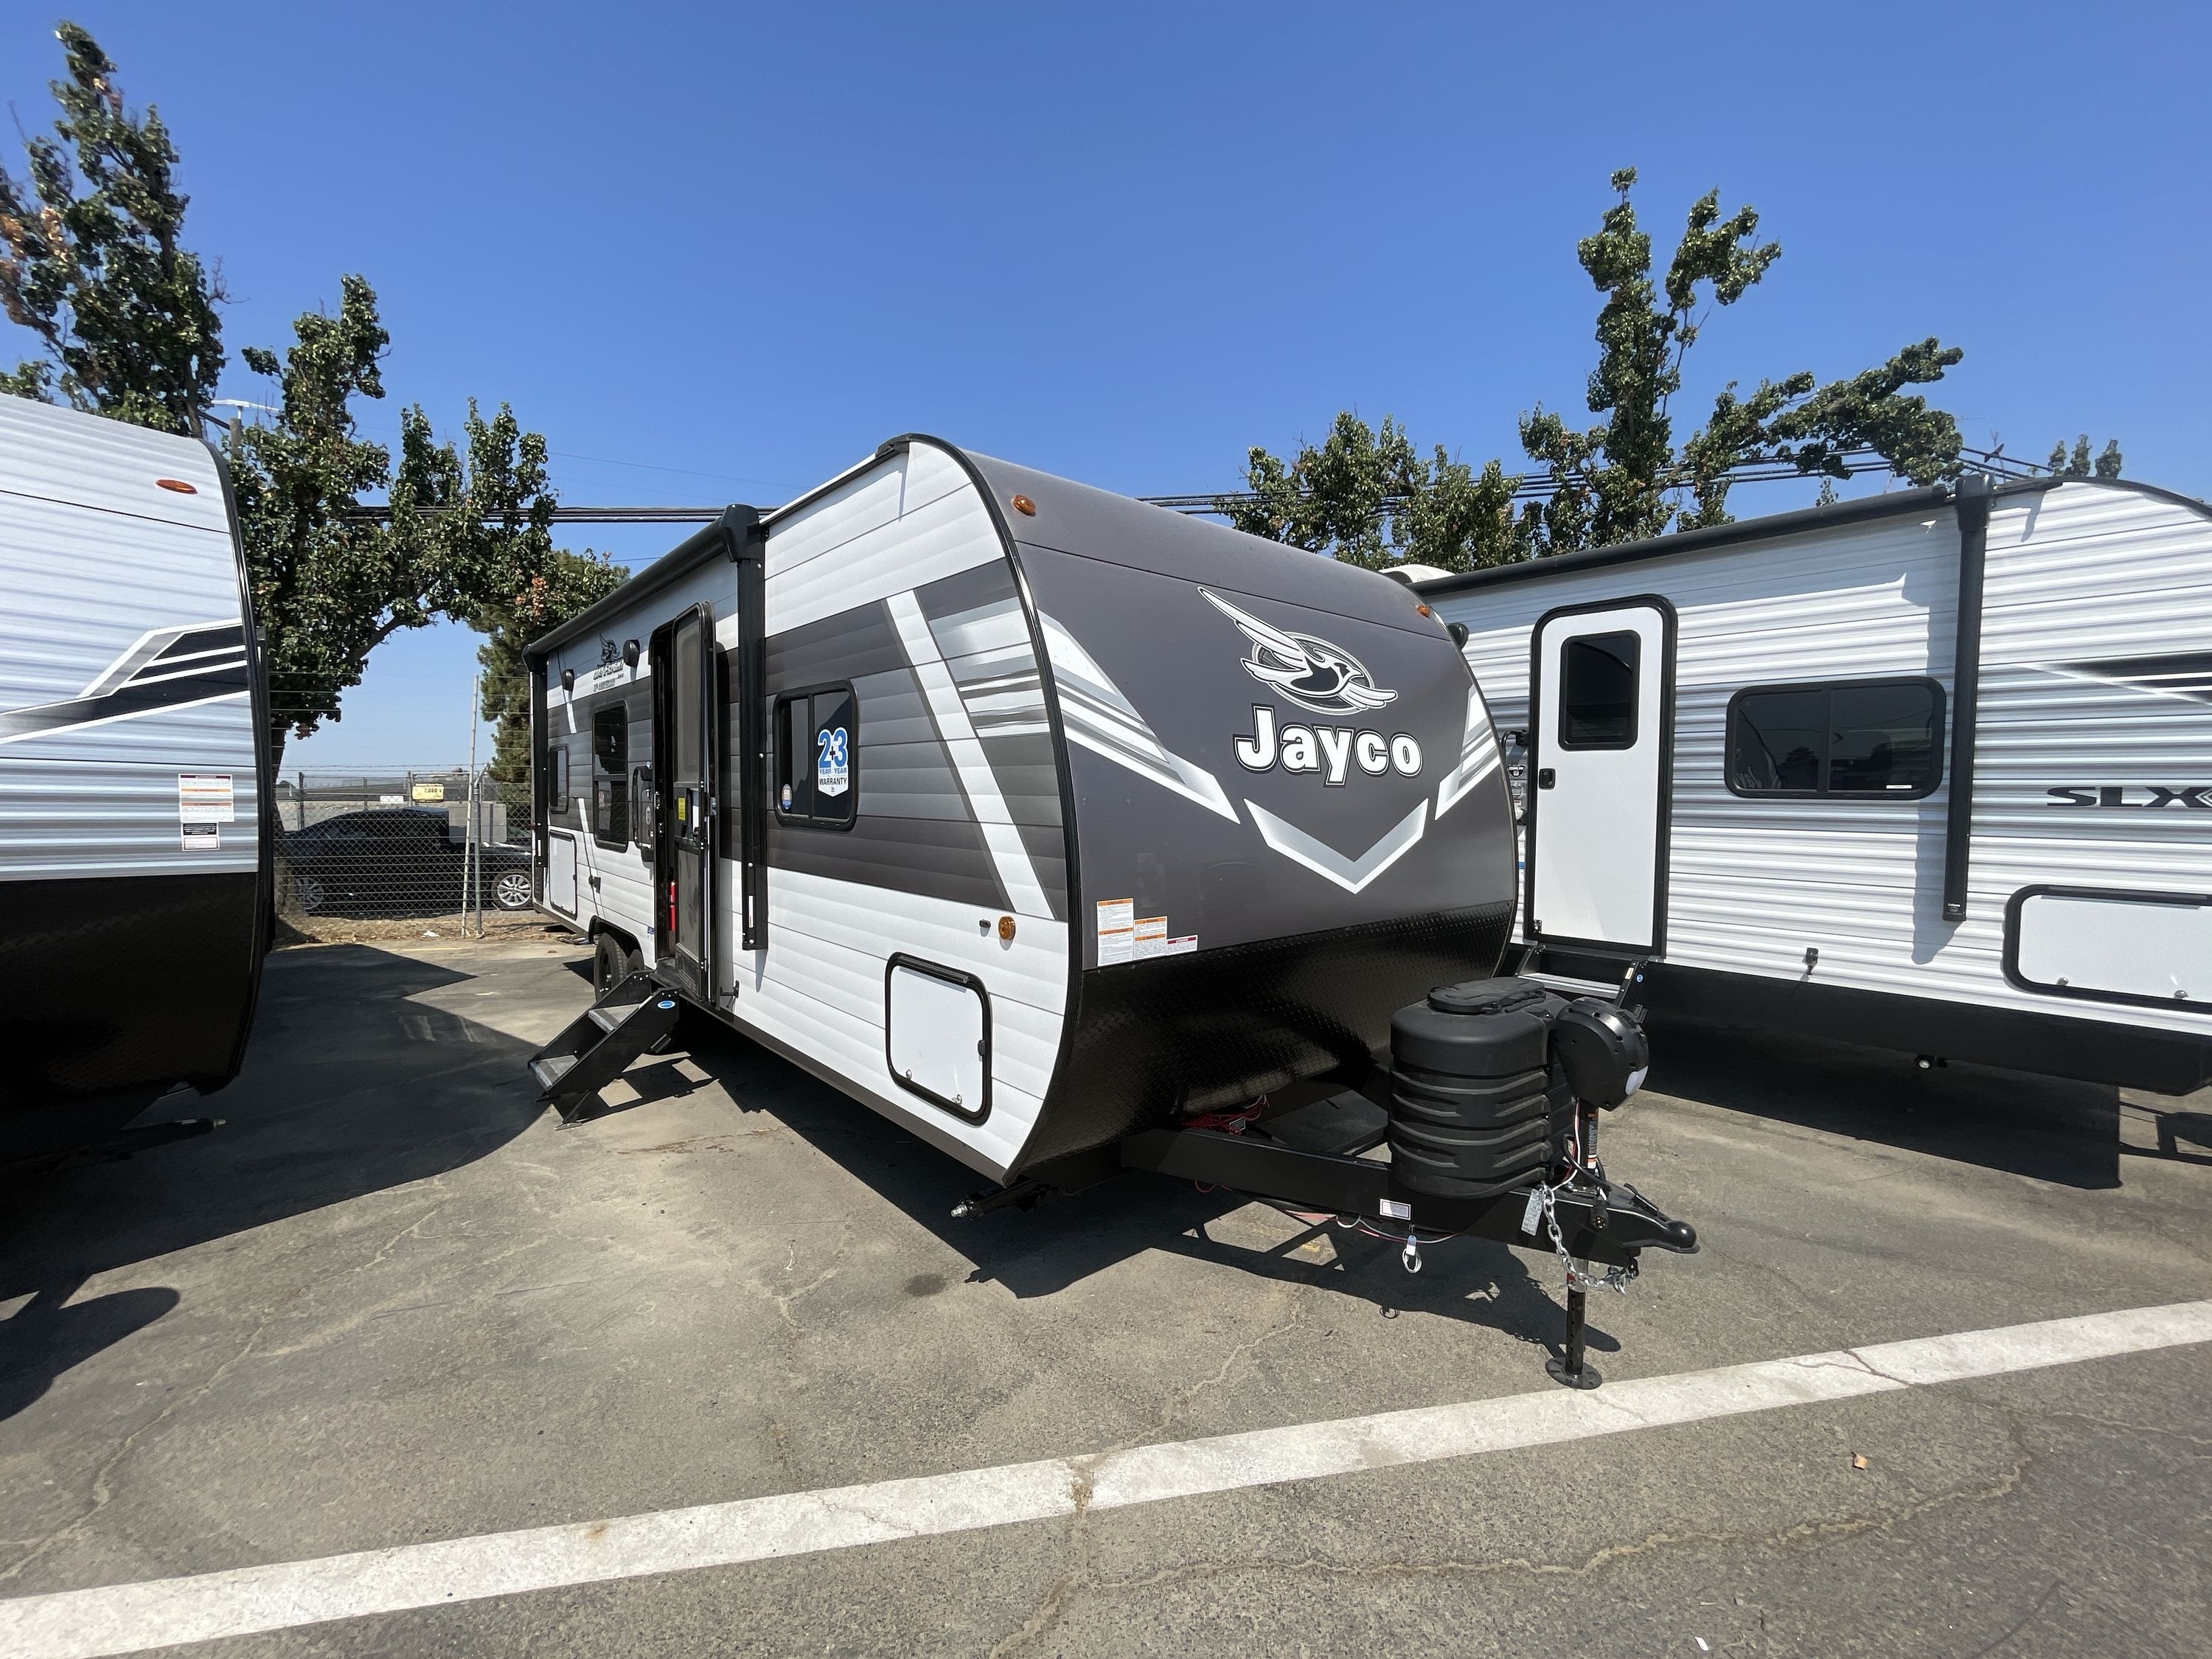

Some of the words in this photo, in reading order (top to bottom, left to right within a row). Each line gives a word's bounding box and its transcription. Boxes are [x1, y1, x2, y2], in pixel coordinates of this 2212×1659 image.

[1232, 702, 1423, 788] Jayco
[819, 777, 847, 785] WARRANTY
[2047, 786, 2212, 808] SLX
